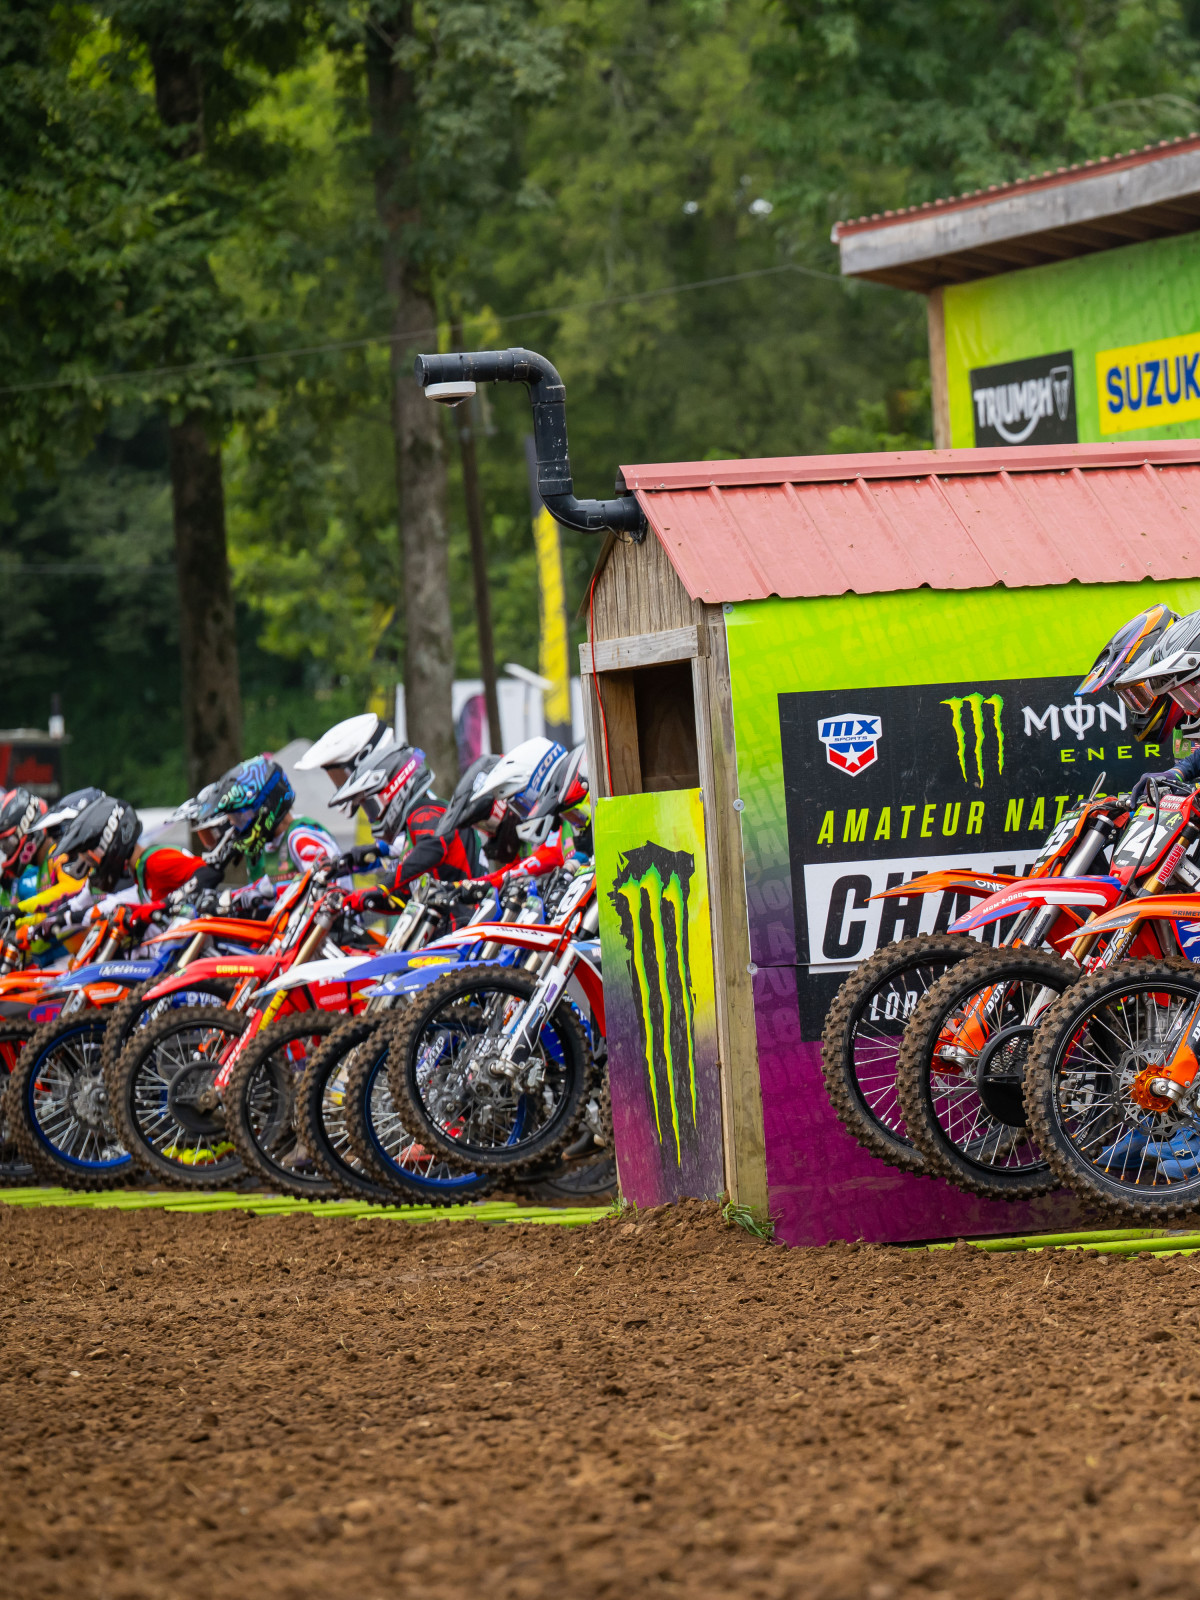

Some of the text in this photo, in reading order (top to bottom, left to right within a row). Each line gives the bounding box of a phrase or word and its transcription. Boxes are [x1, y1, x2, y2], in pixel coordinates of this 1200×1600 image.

[973, 374, 1054, 441] TRIUMPH
[821, 718, 879, 738] MX
[382, 757, 417, 799] LUCID
[100, 803, 125, 851] 100%
[817, 800, 985, 846] AMATEUR
[1114, 820, 1169, 860] 14
